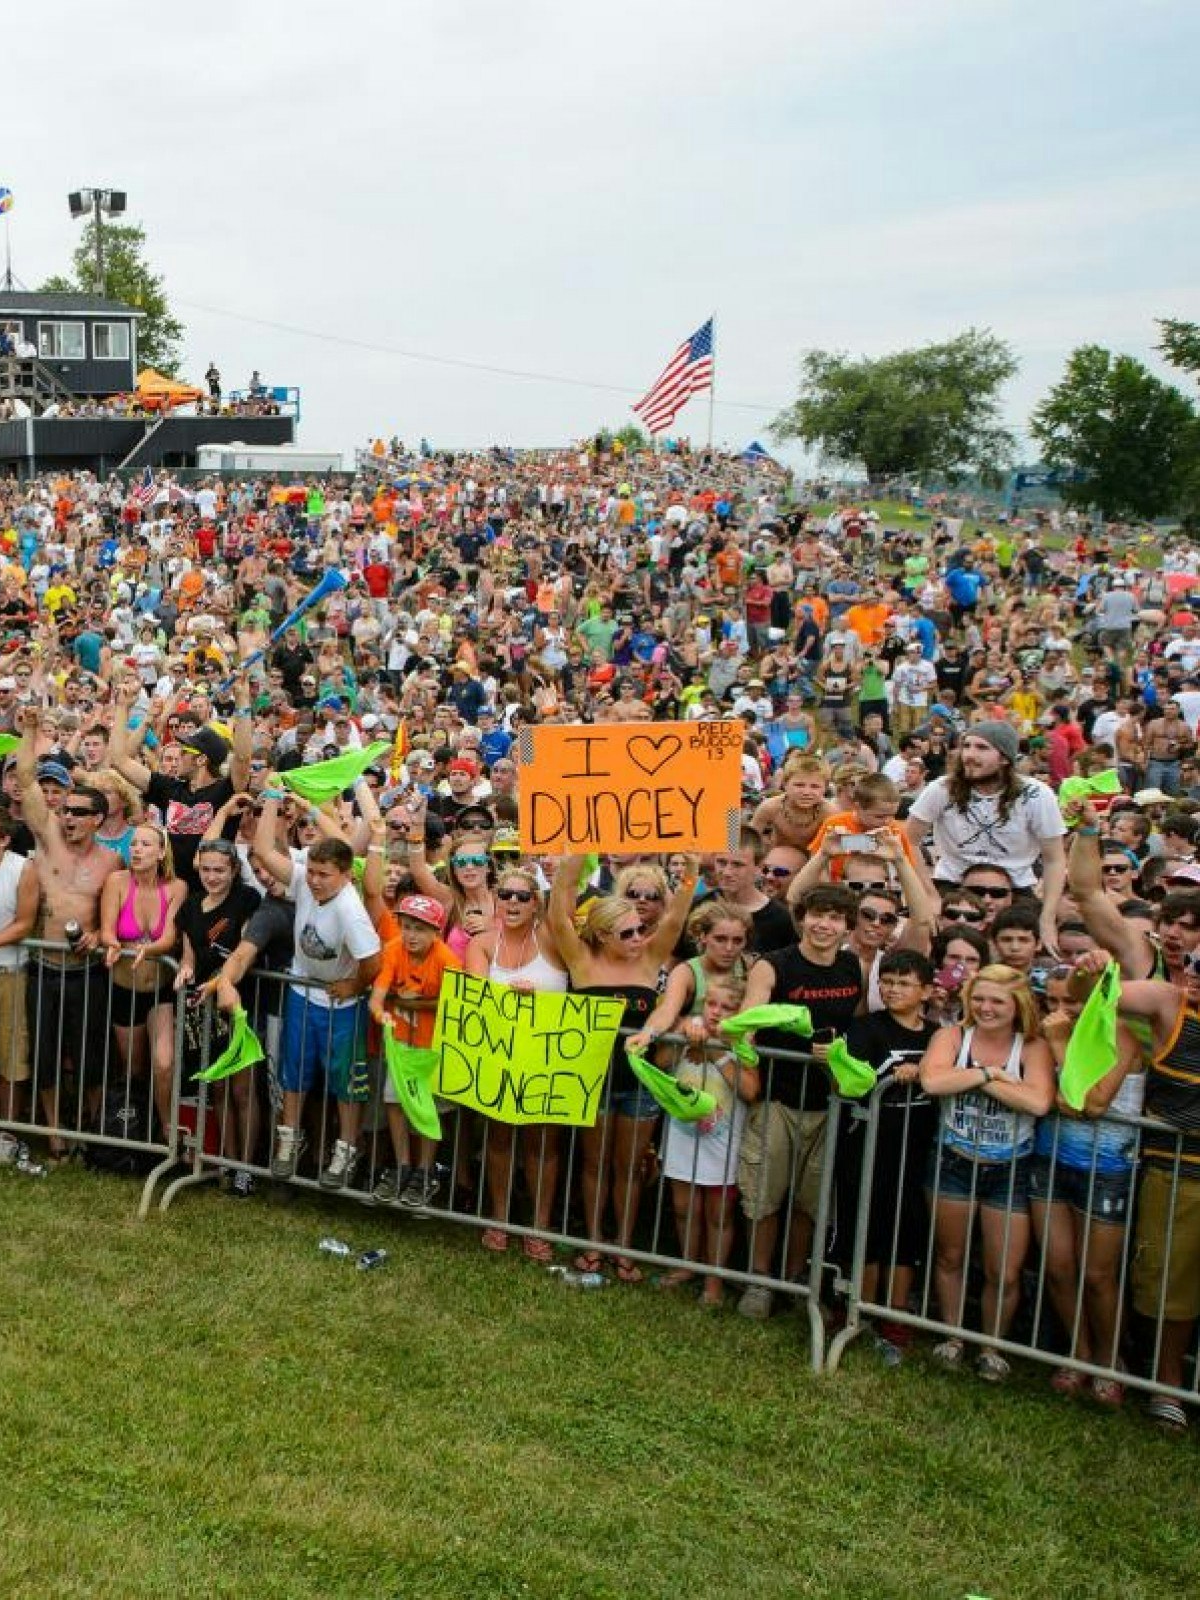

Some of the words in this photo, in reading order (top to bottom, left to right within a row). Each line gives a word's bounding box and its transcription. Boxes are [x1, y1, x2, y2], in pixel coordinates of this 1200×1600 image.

[698, 721, 732, 735] RED
[707, 748, 725, 760] 13
[562, 737, 610, 778] I
[444, 969, 535, 1028] TEACH
[559, 995, 622, 1033] ME
[442, 1000, 516, 1061] HOW
[532, 1027, 587, 1066] TO
[439, 1041, 603, 1121] DUNGEY
